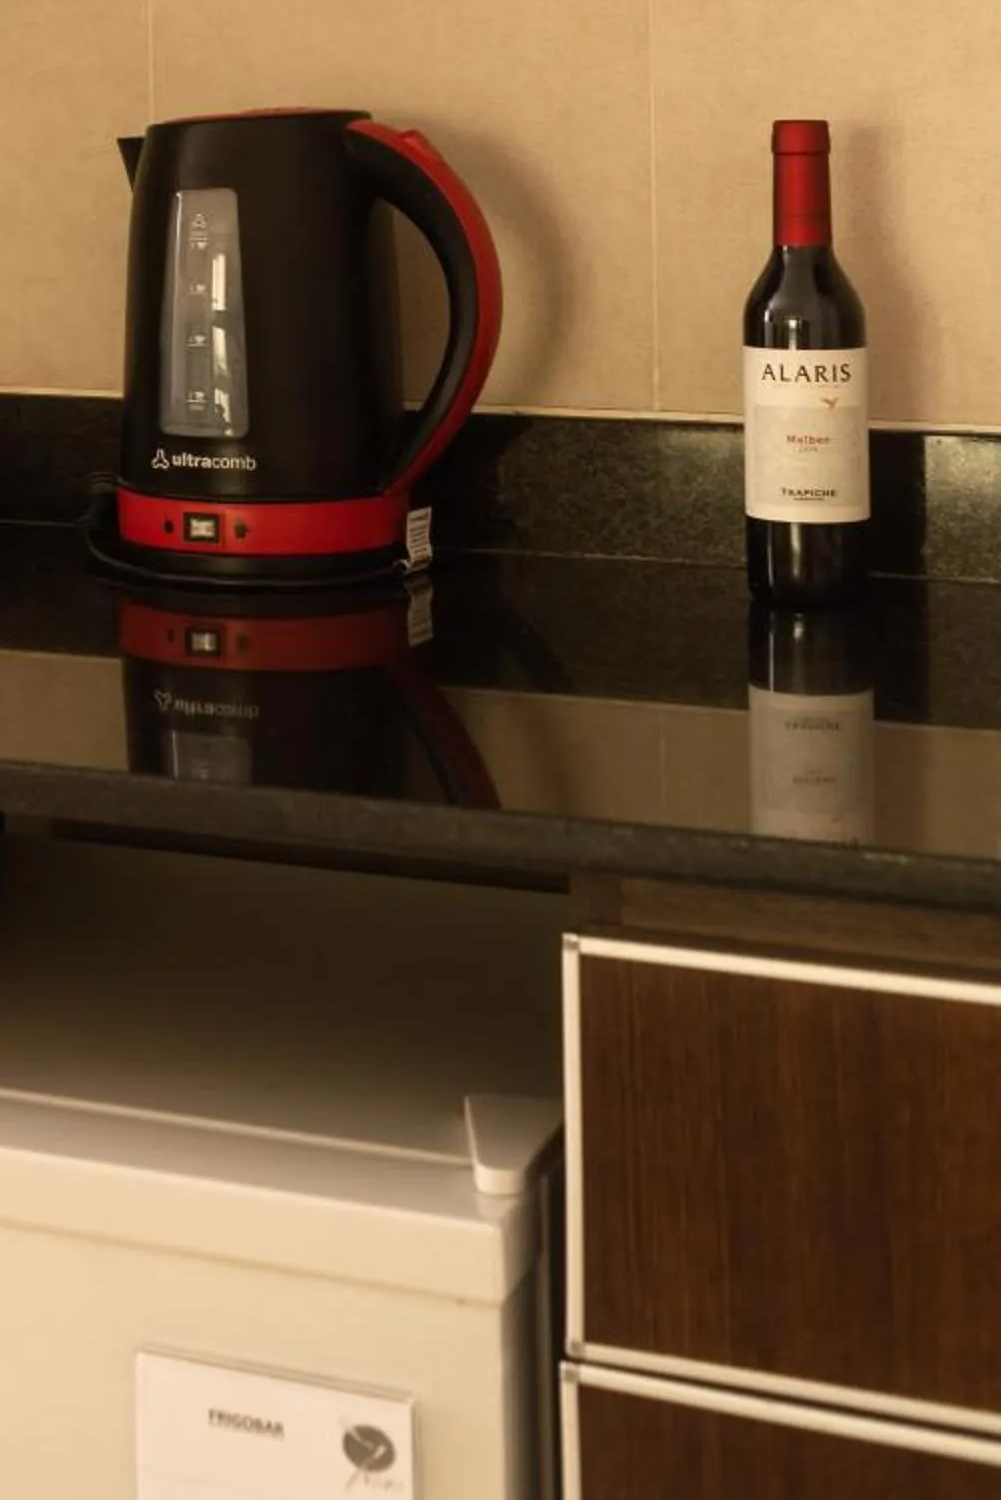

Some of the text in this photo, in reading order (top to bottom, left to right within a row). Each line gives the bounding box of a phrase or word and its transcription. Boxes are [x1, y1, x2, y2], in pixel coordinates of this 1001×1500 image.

[761, 363, 853, 383] ALARIS
[172, 451, 257, 472] ultracomb
[207, 1408, 285, 1441] FRIGOBAR
